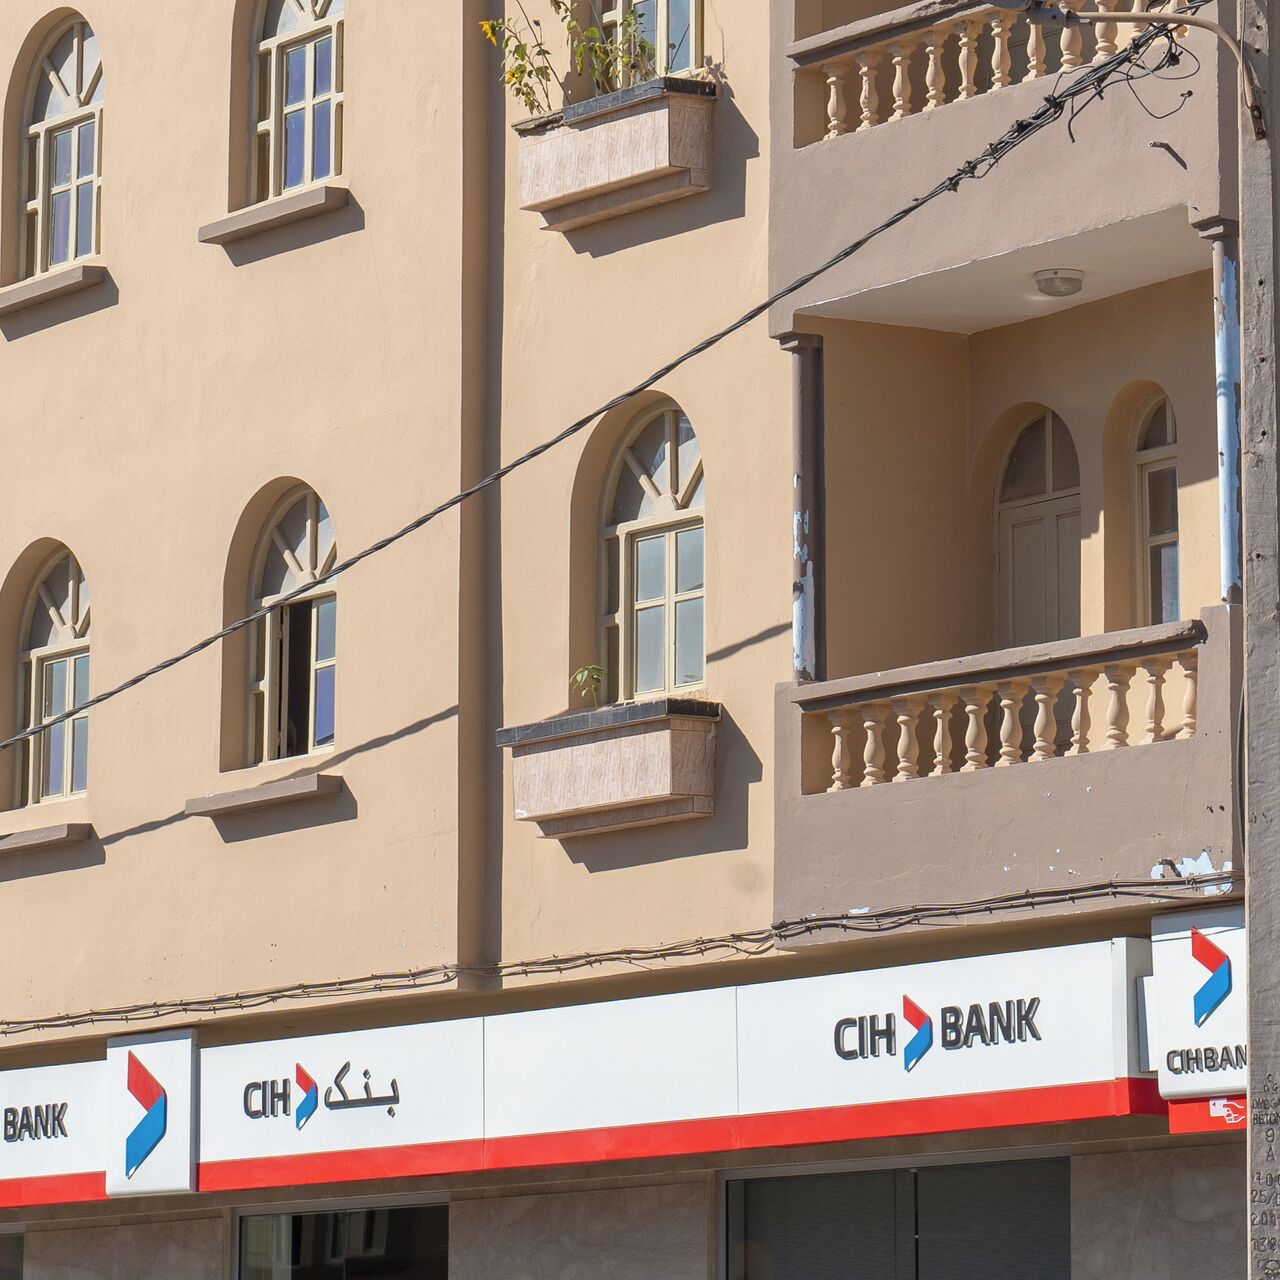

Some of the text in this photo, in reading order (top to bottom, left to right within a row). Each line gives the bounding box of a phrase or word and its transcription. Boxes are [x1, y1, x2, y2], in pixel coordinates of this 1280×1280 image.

[834, 997, 1042, 1060] CIH BANK
[243, 1077, 290, 1119] CIH
[3, 1102, 68, 1143] BANK
